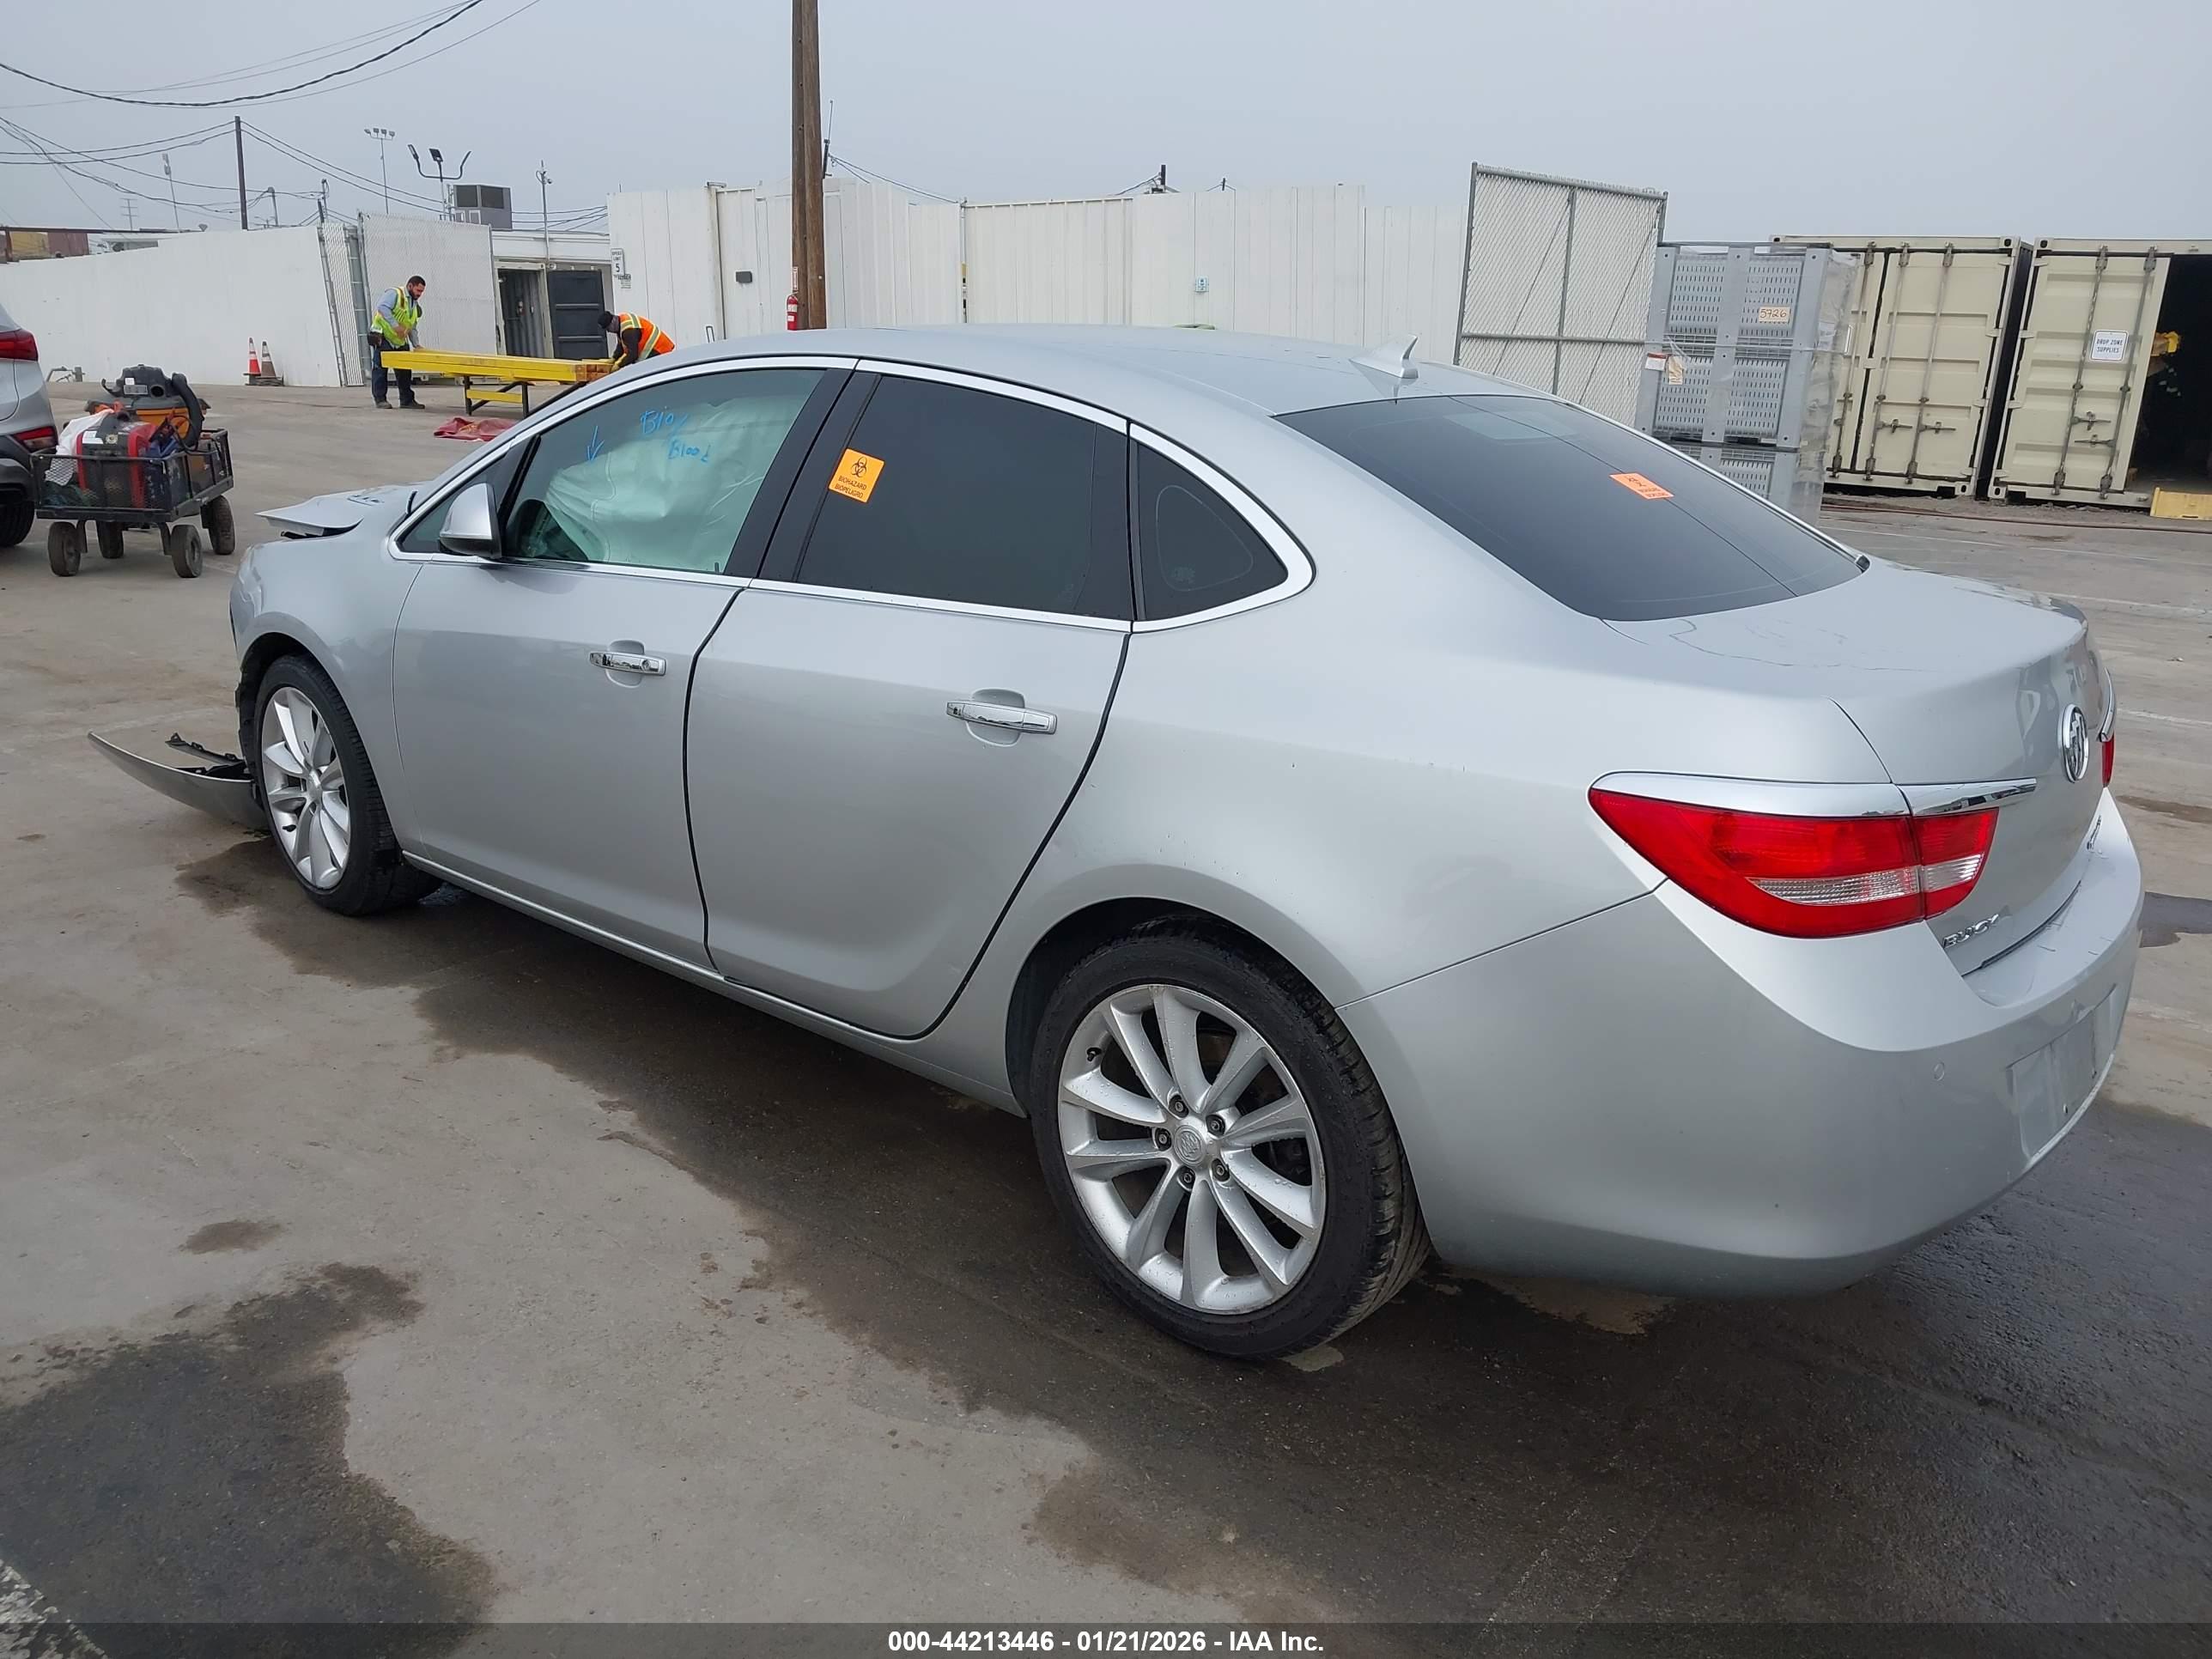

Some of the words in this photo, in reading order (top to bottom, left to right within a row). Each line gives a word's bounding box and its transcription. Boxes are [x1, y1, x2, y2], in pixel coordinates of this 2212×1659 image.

[615, 263, 620, 272] 5
[1760, 308, 1787, 319] 5726
[838, 475, 867, 490] BIOHAZARD
[835, 483, 863, 498] BIOPELIGRO
